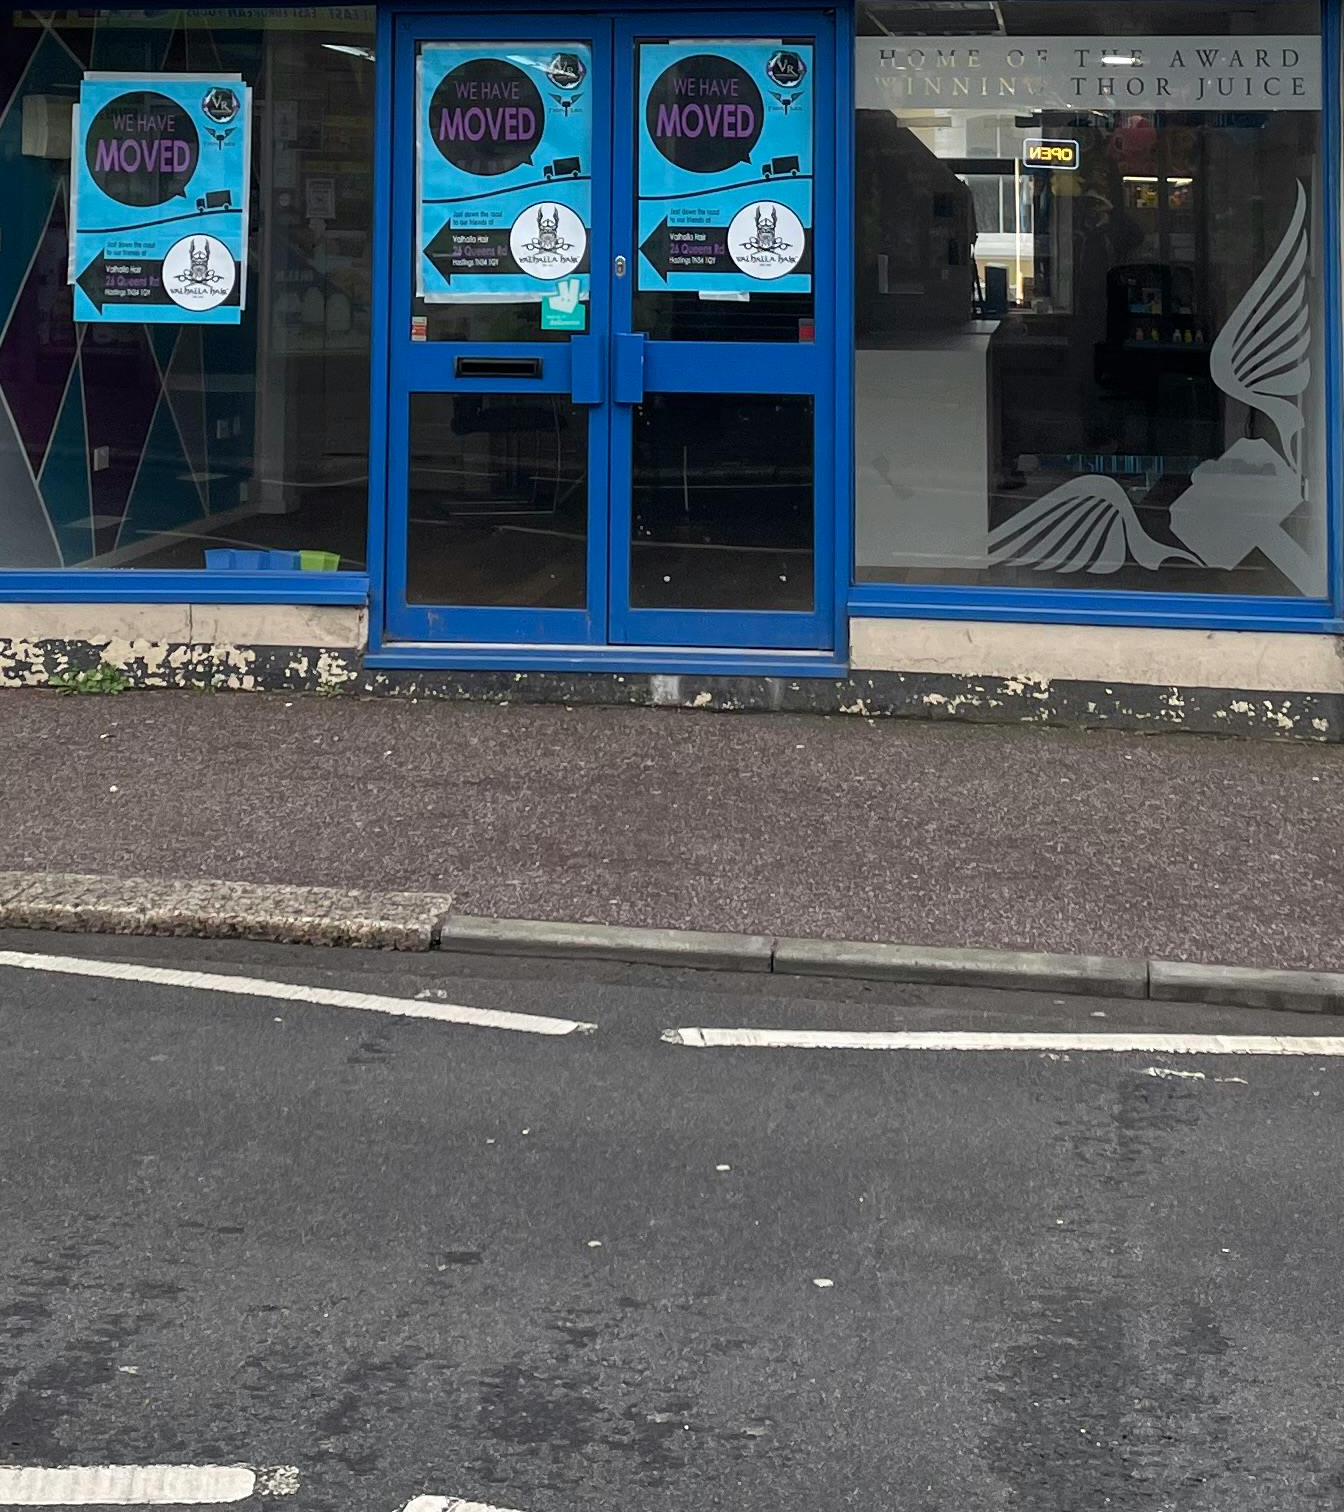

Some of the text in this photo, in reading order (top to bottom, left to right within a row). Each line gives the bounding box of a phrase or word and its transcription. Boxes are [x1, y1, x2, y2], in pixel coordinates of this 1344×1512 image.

[879, 49, 981, 69] HOME
[1074, 48, 1145, 68] THE
[1168, 48, 1300, 68] AWARD
[456, 81, 521, 100] WE HAVE
[673, 78, 740, 97] WE HAVE
[1070, 76, 1172, 96] THOR
[1195, 76, 1307, 100] JUICE
[112, 112, 176, 132] WE HAVE
[438, 107, 536, 142] MOVED
[656, 103, 755, 138] MOVED
[94, 139, 191, 173] MOVED
